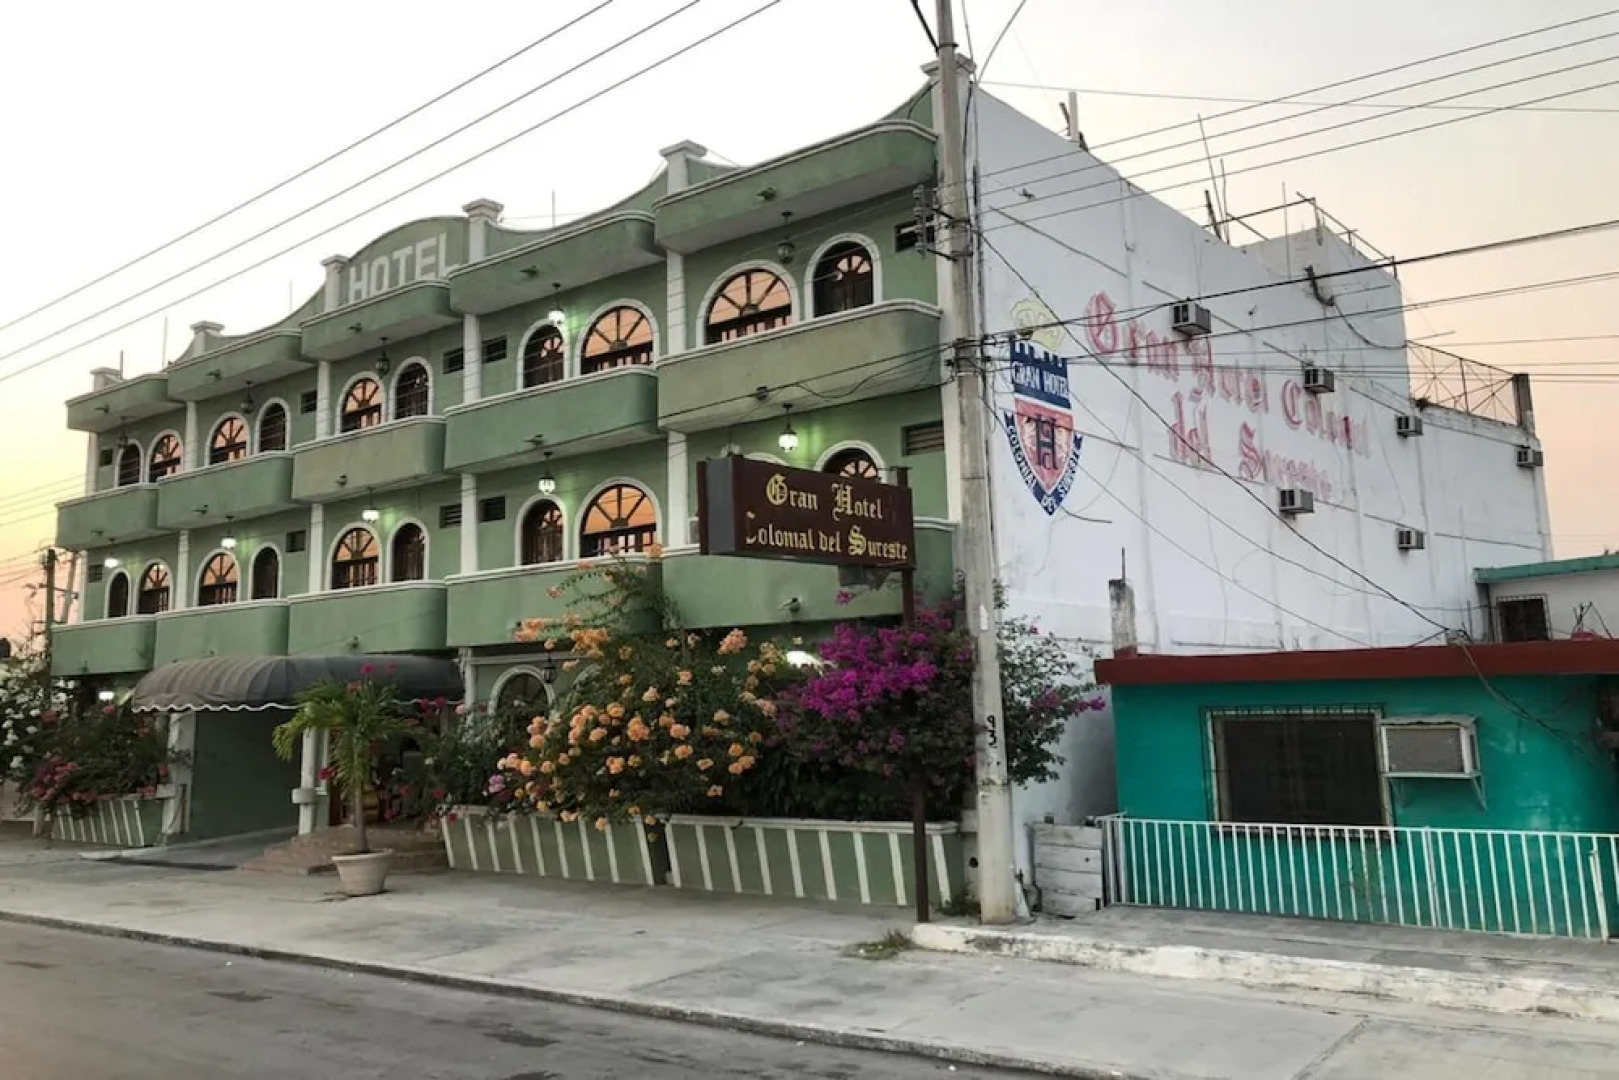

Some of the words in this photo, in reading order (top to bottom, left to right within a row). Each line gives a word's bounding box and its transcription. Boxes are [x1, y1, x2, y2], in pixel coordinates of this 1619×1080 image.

[347, 232, 460, 304] HOTEL
[1011, 361, 1041, 390] GRAN
[766, 473, 819, 511] Gran
[831, 482, 883, 522] Hotel
[818, 530, 841, 553] del
[848, 525, 908, 560] Sureste
